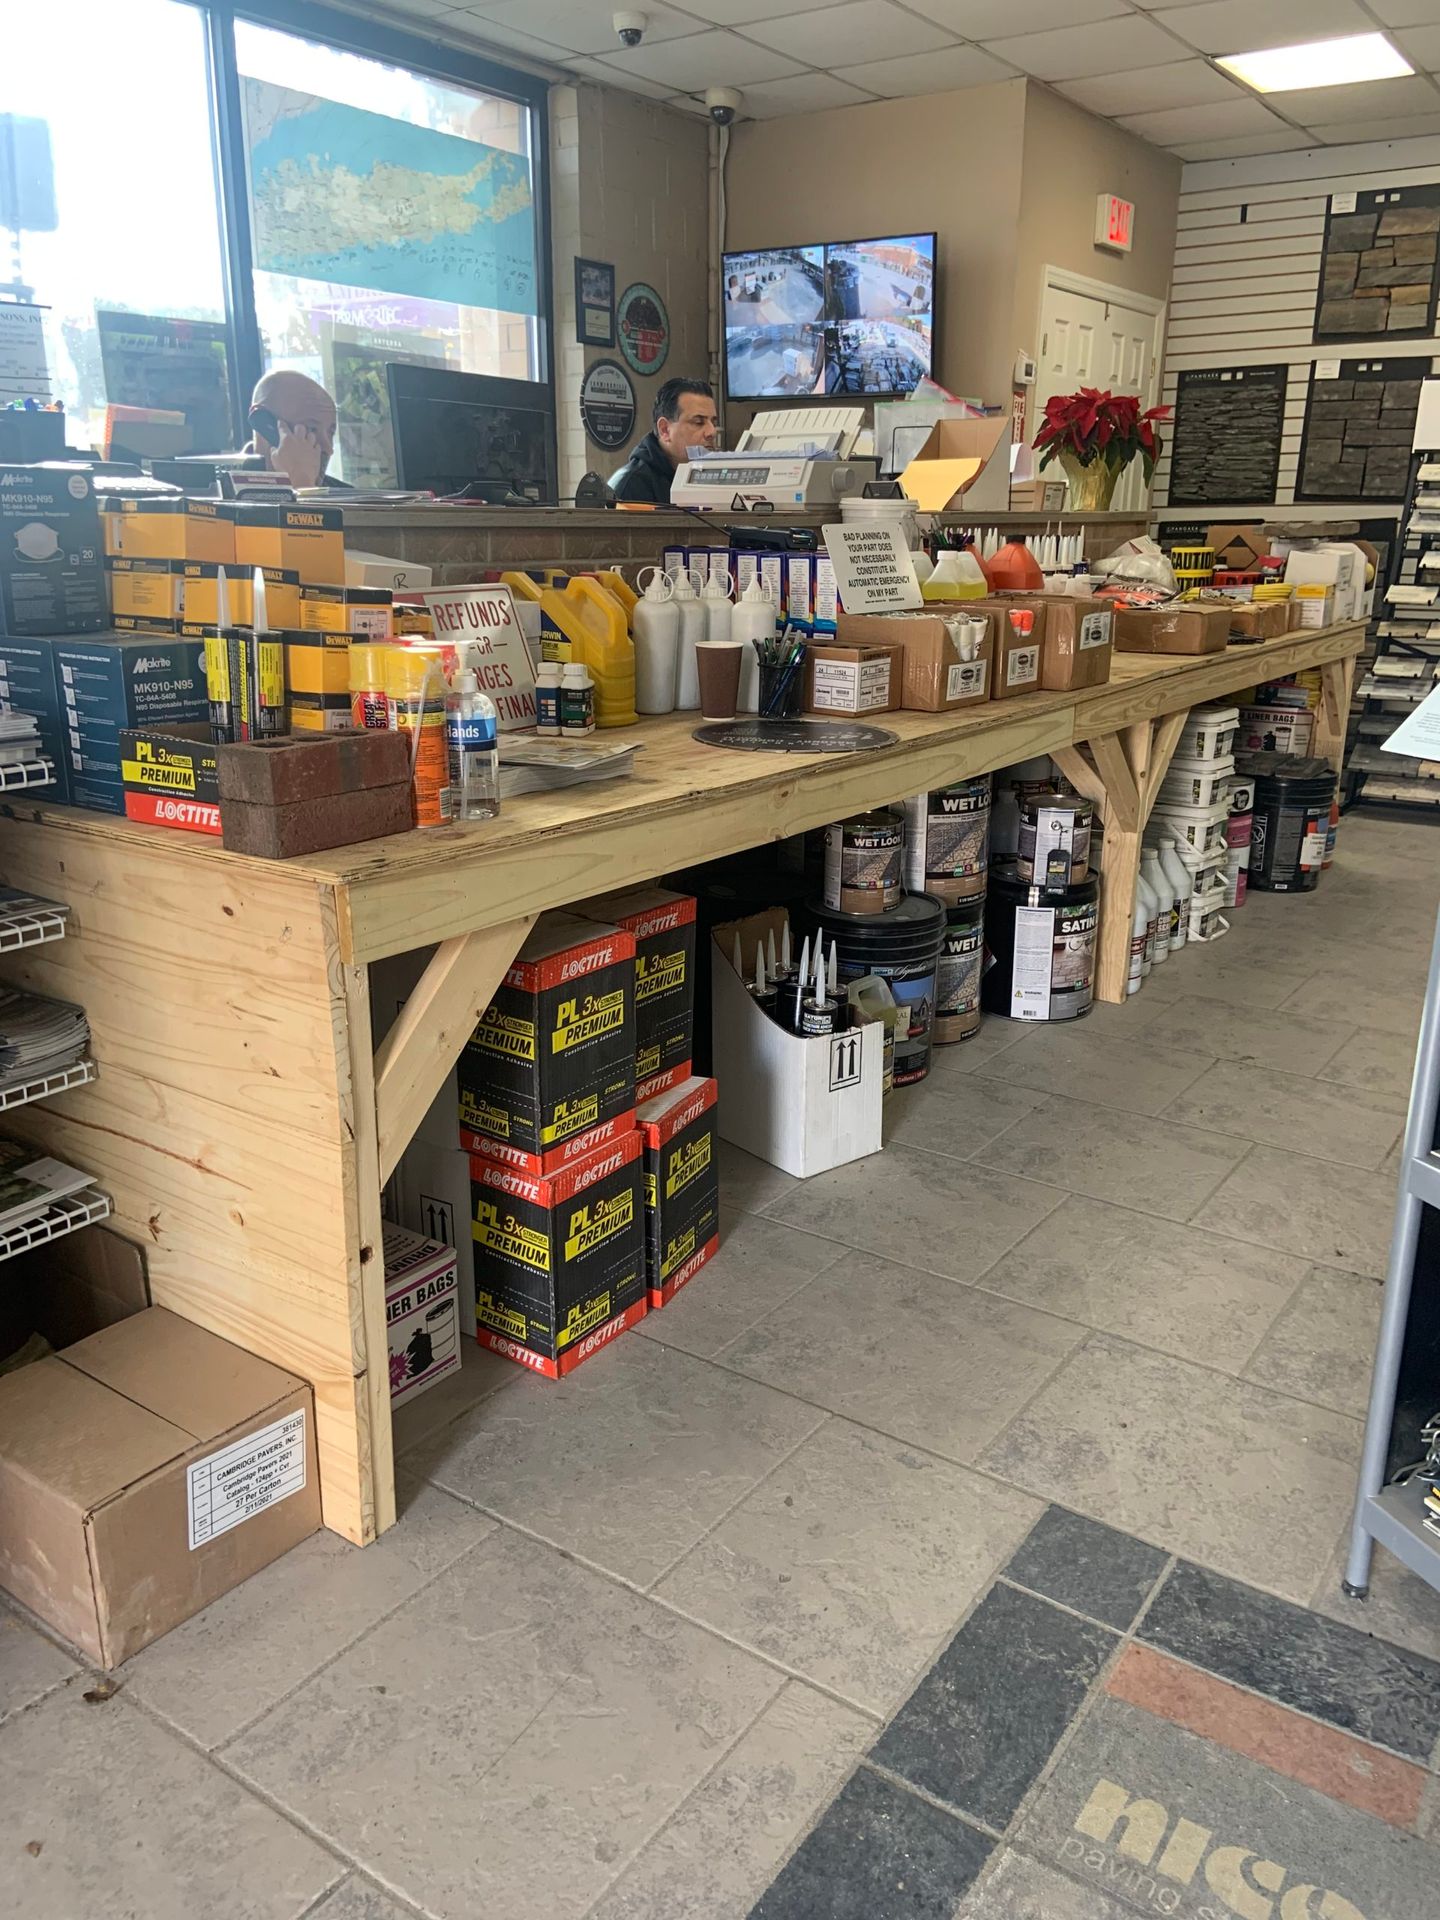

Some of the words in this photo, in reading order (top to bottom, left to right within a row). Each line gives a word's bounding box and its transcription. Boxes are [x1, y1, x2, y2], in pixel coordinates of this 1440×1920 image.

[1109, 196, 1131, 245] EXIT
[286, 512, 324, 526] DEWALT
[842, 532, 855, 541] BAD
[856, 531, 882, 541] PLANNING
[882, 531, 891, 540] ON
[848, 543, 863, 552] YOUR
[863, 543, 877, 551] PART
[878, 542, 892, 551] DOES
[82, 550, 93, 559] 20
[849, 555, 860, 564] NOT
[861, 553, 896, 563] NECESSARILY
[848, 578, 879, 587] AUTOMATIC
[879, 575, 910, 585] EMERGENCY
[856, 566, 888, 575] CONSTITUTE
[889, 565, 897, 573] AN
[867, 589, 875, 598] ON
[876, 588, 883, 597] MY
[885, 587, 898, 596] PART
[433, 599, 512, 631] REFUNDS
[475, 636, 493, 655] OR
[132, 656, 171, 674] Makrite
[134, 680, 194, 694] MK910-N95
[149, 701, 182, 710] Disposable
[1272, 714, 1295, 723] BAGS
[136, 741, 158, 763] PL
[155, 800, 219, 828] LOCTITE
[942, 796, 977, 812] WET
[854, 838, 879, 847] WET
[634, 911, 679, 939] LOCTITE
[1061, 916, 1095, 933] SATIN
[948, 936, 976, 953] WET
[561, 948, 613, 980] LOCTITE
[556, 998, 580, 1028] PL
[583, 995, 600, 1013] 3x
[564, 1039, 598, 1058] Construction
[599, 1029, 623, 1042] Adhesive
[506, 1056, 533, 1069] Adhesive
[604, 1080, 627, 1095] STRONG
[636, 1071, 673, 1099] OCTITE
[461, 1090, 476, 1109] PL
[513, 1115, 533, 1127] STRONG
[553, 1101, 569, 1122] PL
[554, 1108, 596, 1137] PREMIUM
[672, 1098, 705, 1135] LOCTITE
[564, 1121, 615, 1160] LOCTITE
[472, 1136, 529, 1168] LOCTITE
[669, 1147, 684, 1176] PL
[574, 1152, 623, 1192] LOCTITE
[483, 1168, 539, 1200] LOCTITE
[477, 1200, 501, 1229] PL
[503, 1215, 523, 1237] 3x
[523, 1229, 548, 1243] STRONGER
[569, 1205, 593, 1238] PL
[593, 1200, 610, 1220] 3x
[576, 1240, 610, 1263] Construction
[610, 1226, 632, 1241] Adhesive
[485, 1249, 521, 1268] Construction
[522, 1264, 549, 1279] Adhesive
[674, 1248, 705, 1289] LOCTITE
[417, 1271, 454, 1306] BAGS
[616, 1272, 636, 1290] STRONG
[479, 1291, 494, 1310] PL
[529, 1319, 550, 1333] STRONG
[567, 1306, 582, 1327] PL
[578, 1313, 625, 1359] LOCTITE
[490, 1335, 545, 1370] LOCTITE
[216, 1453, 257, 1481] CAMBRIDGE
[223, 1471, 257, 1493] Cambridge
[257, 1459, 278, 1476] Pavers
[278, 1450, 293, 1464] 2021
[226, 1482, 250, 1501] Catalog
[235, 1498, 244, 1509] 27
[245, 1491, 257, 1504] Per
[258, 1478, 282, 1495] Carton
[1055, 1836, 1182, 1916] paving
